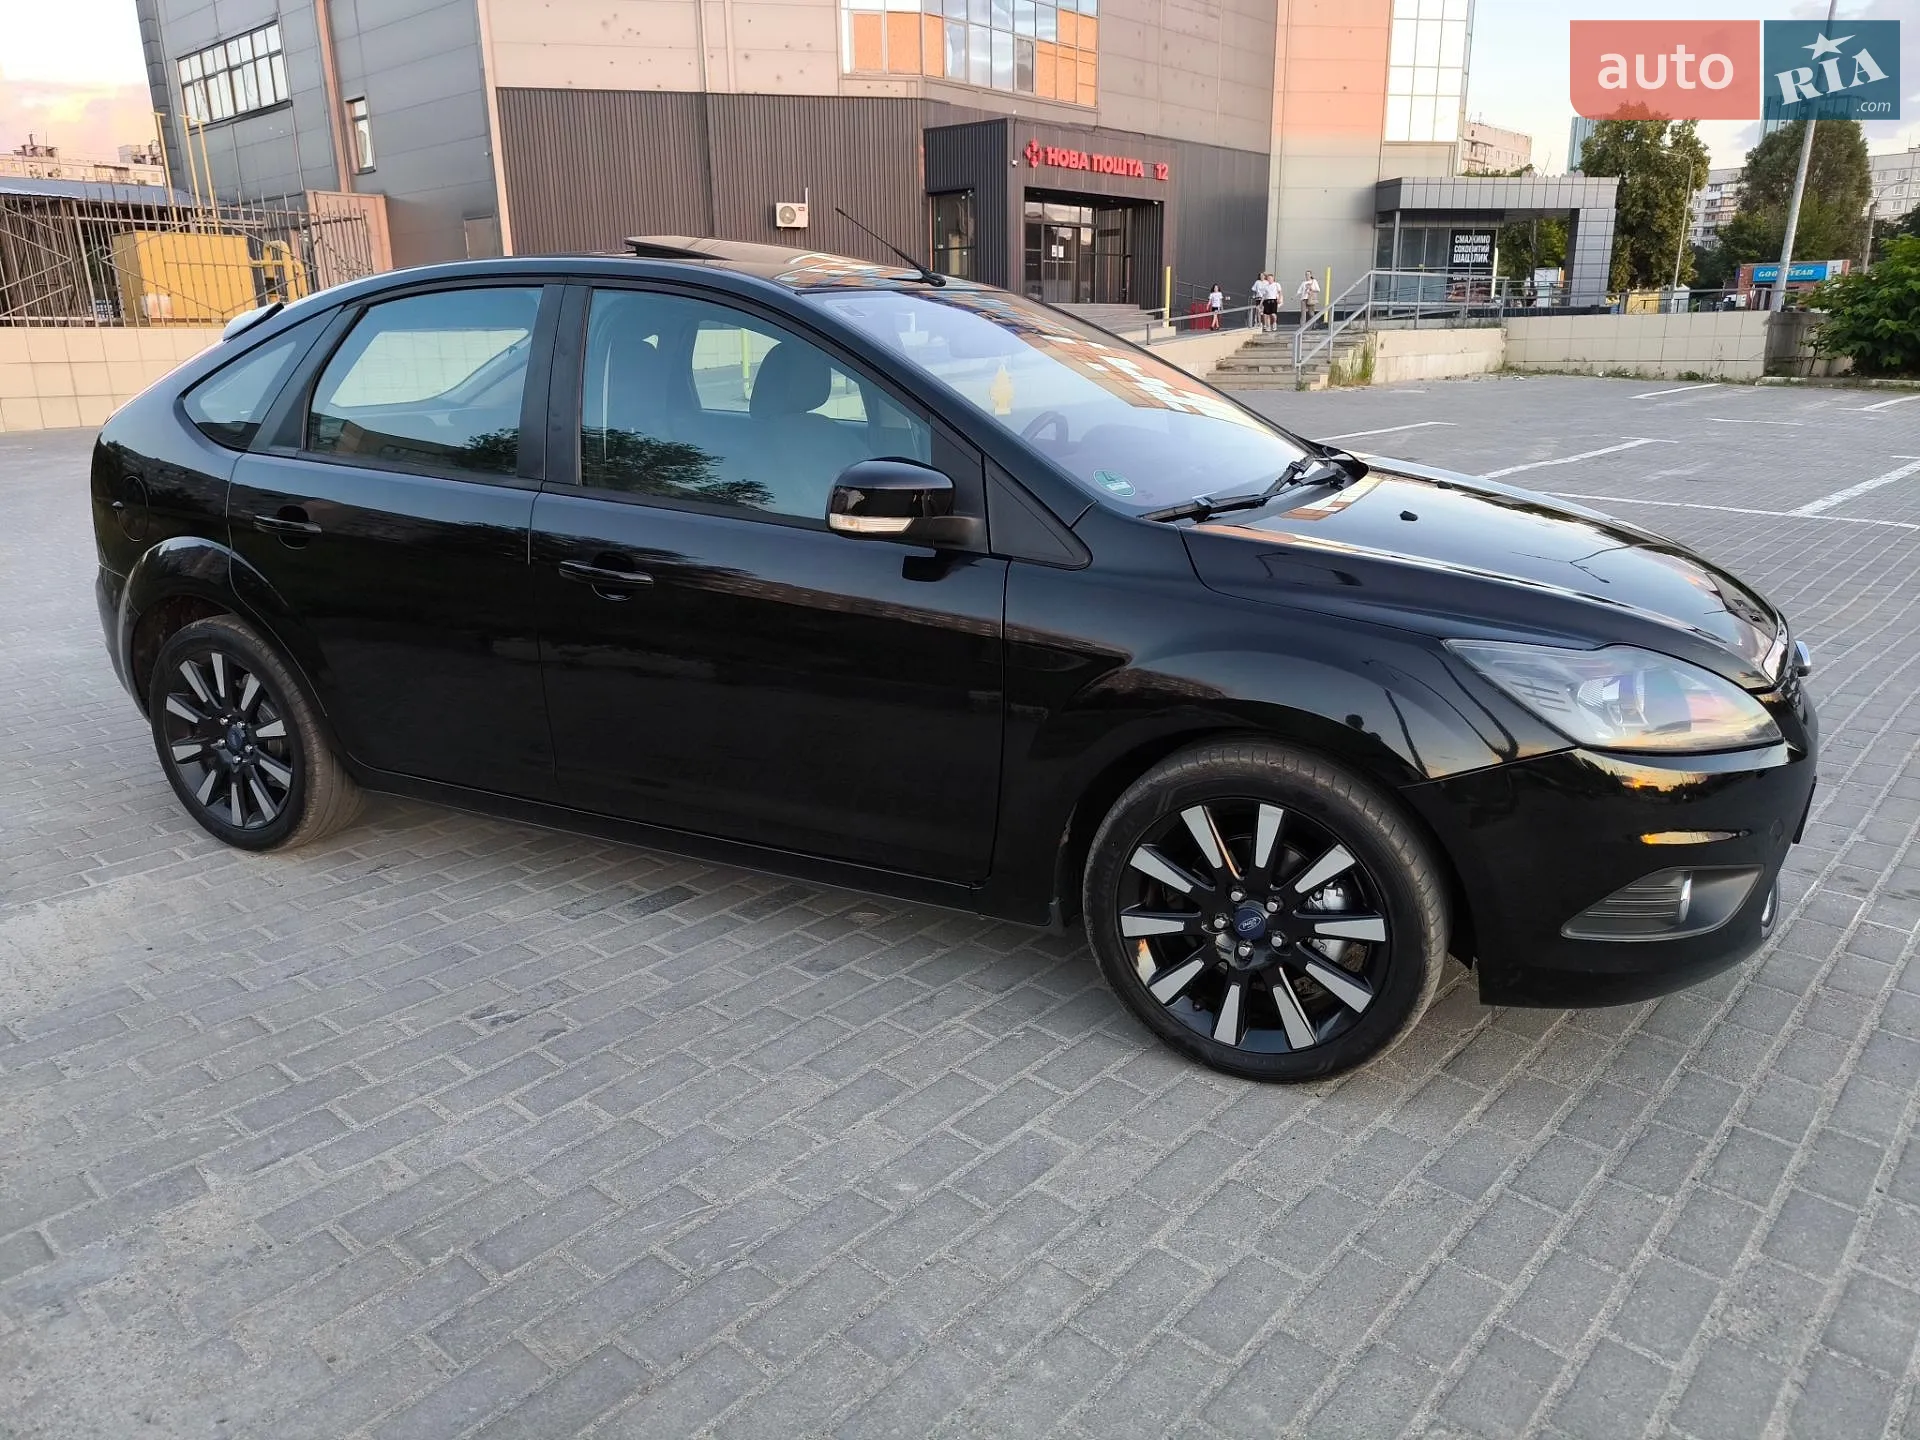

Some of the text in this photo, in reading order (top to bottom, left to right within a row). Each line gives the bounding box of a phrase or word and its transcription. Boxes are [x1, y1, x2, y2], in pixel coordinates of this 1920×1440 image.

[1046, 146, 1169, 180] НОВА ПОШТА 12
[1758, 269, 1814, 278] GOOYEAR
